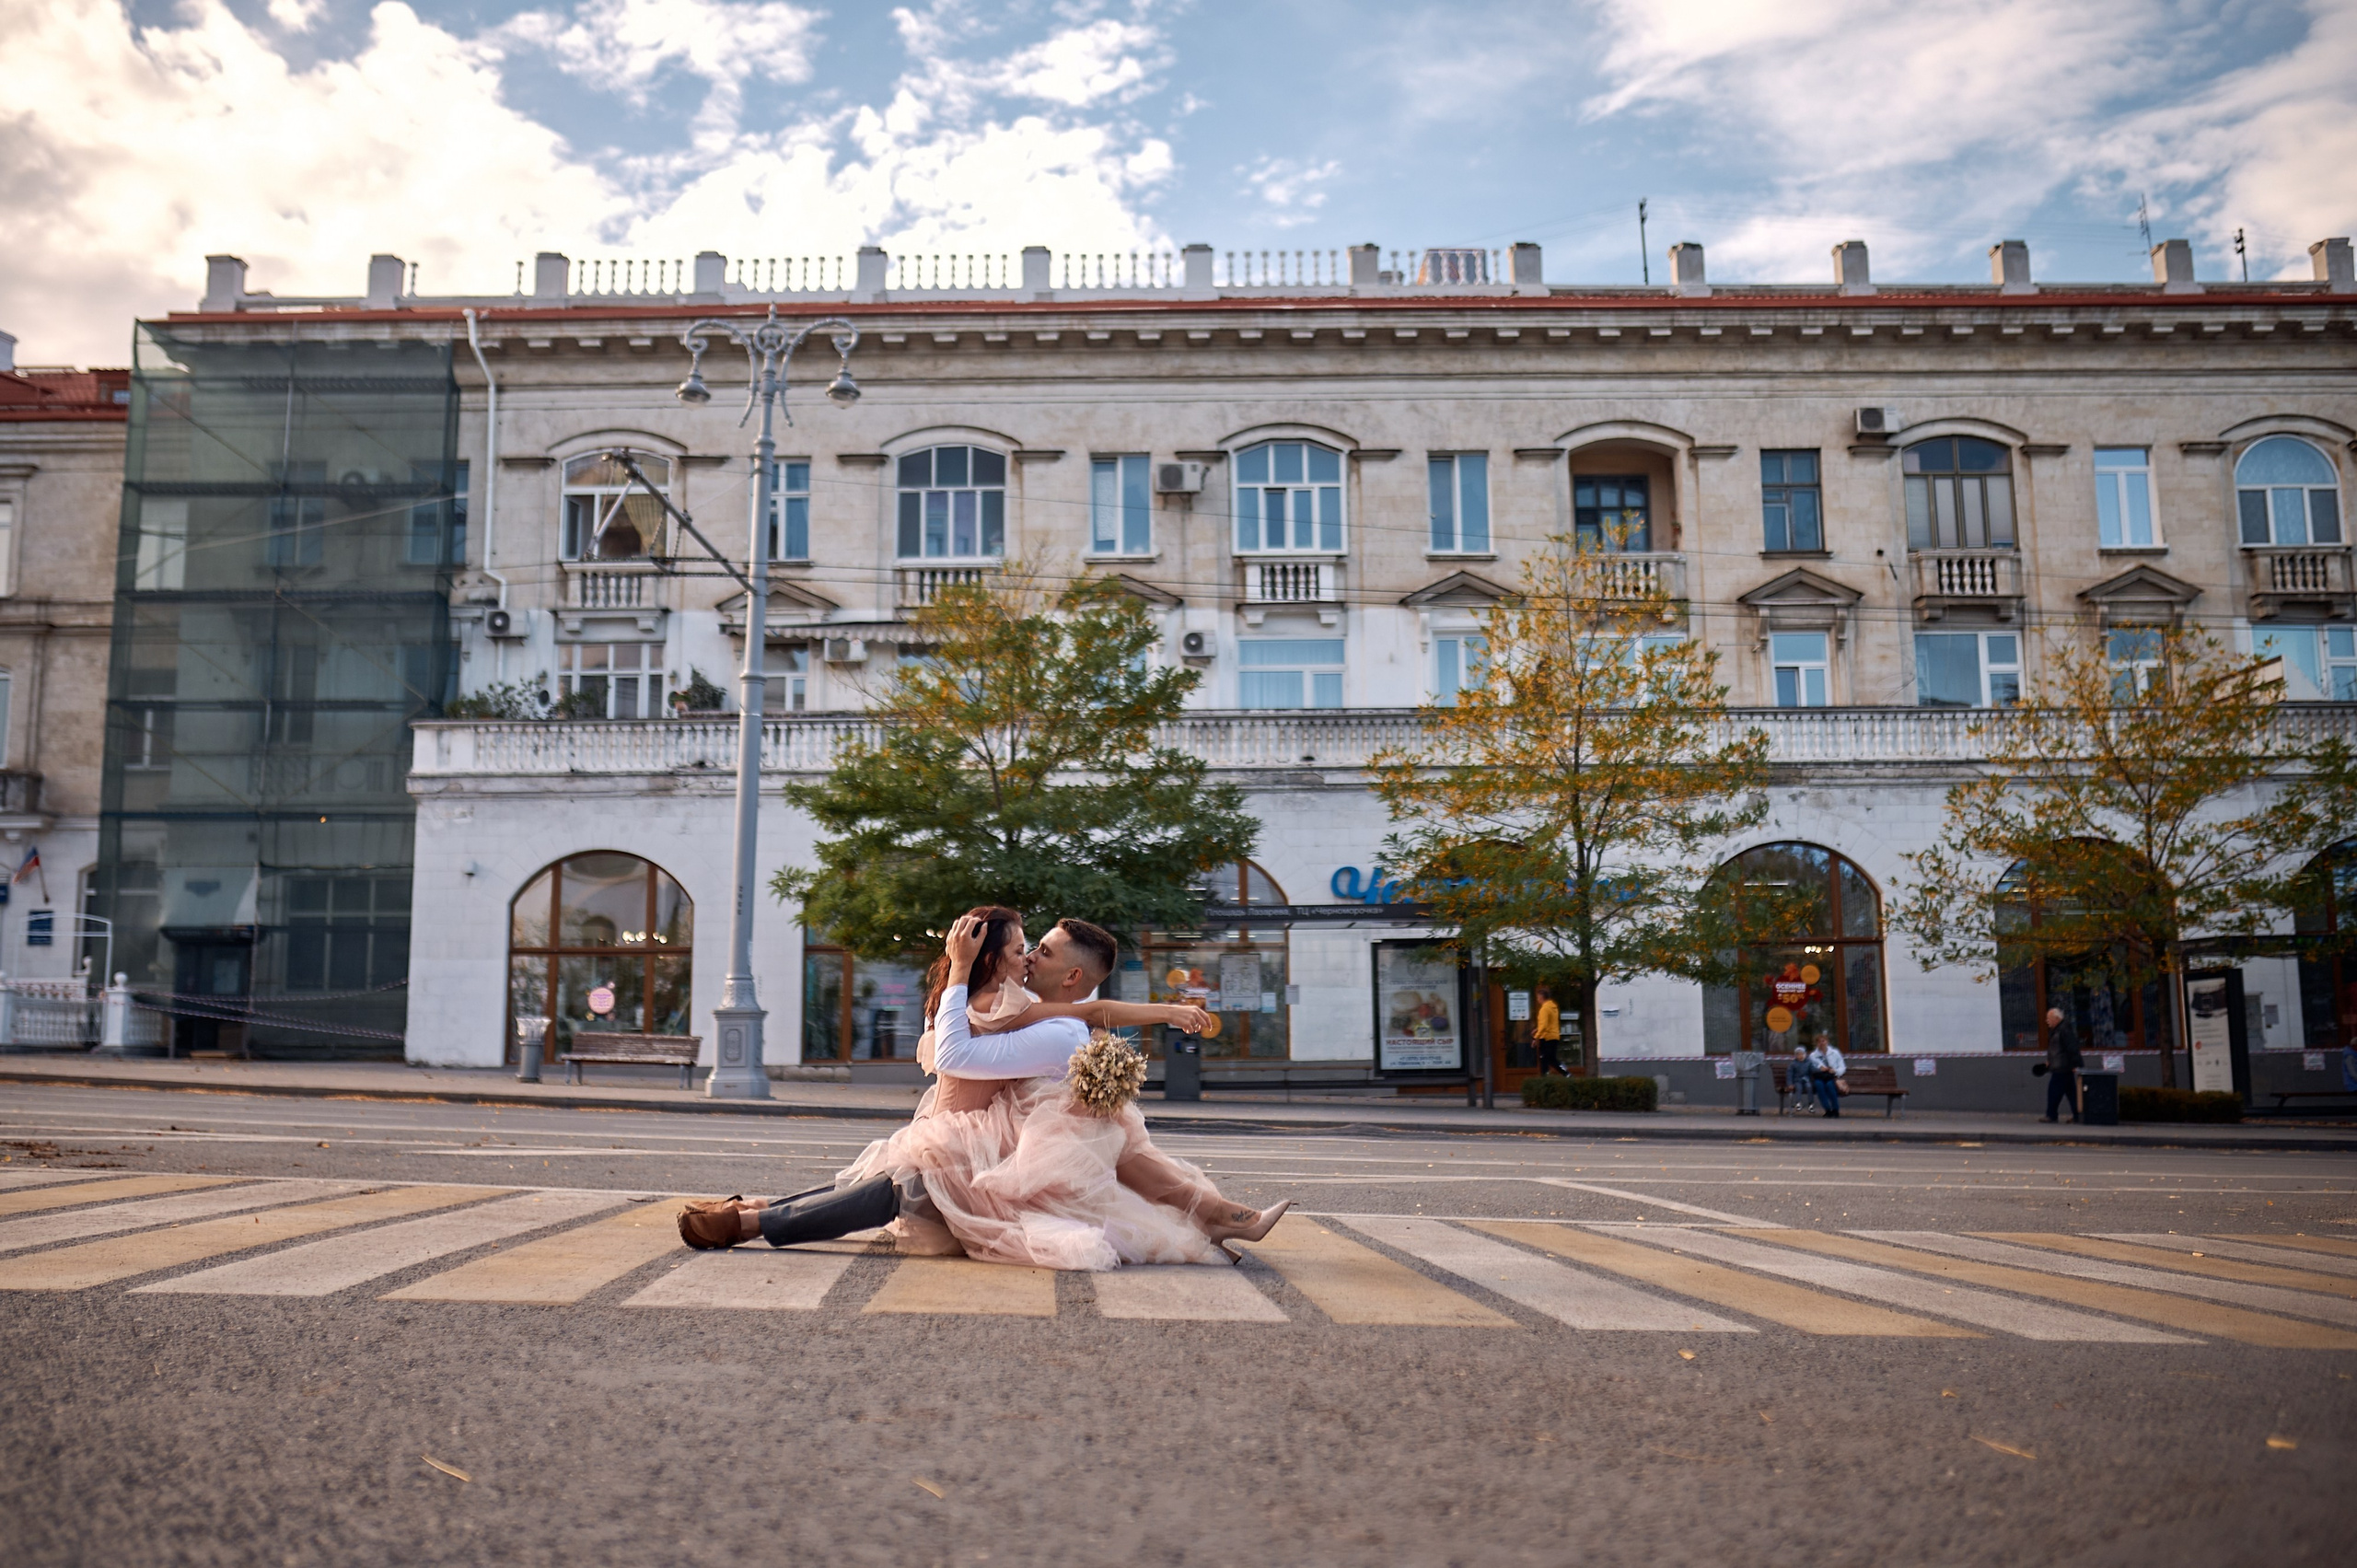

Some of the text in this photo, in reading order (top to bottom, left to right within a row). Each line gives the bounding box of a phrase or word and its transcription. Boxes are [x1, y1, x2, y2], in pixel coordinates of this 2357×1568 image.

[1205, 907, 1246, 917] Площадь
[1296, 907, 1309, 916] ТЦ
[1311, 906, 1384, 915] «Черноморочка»
[1386, 1038, 1435, 1046] НАСТОЯЩИЙ
